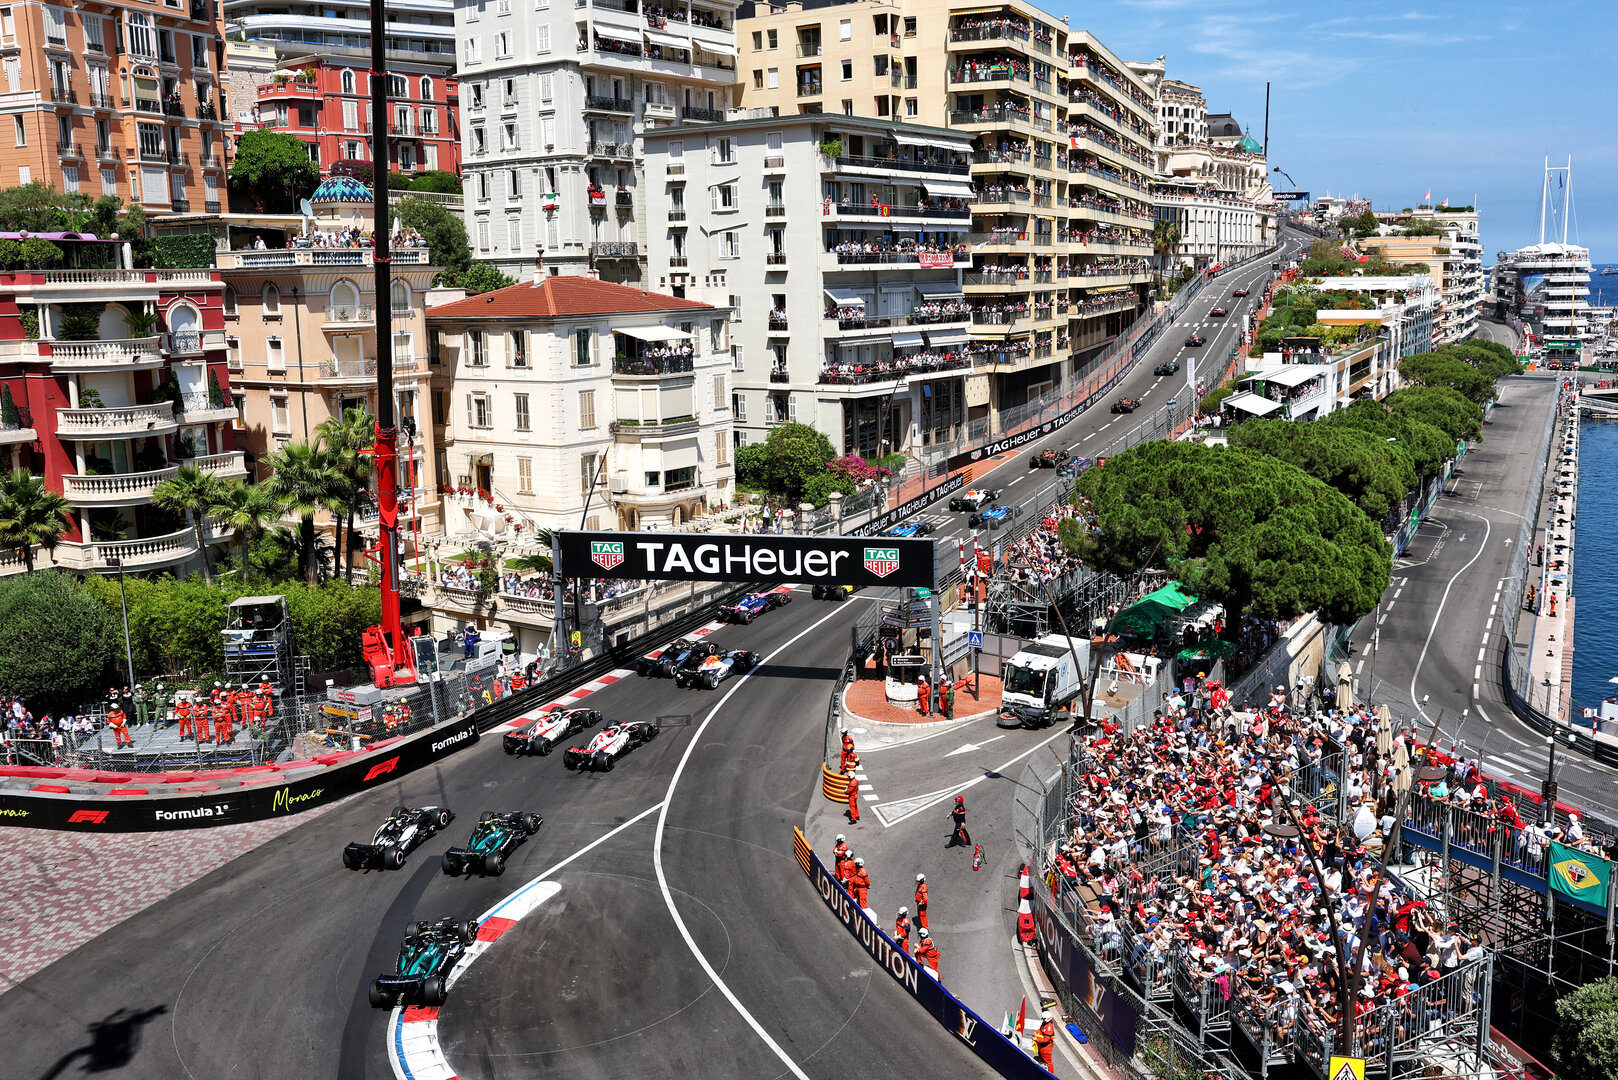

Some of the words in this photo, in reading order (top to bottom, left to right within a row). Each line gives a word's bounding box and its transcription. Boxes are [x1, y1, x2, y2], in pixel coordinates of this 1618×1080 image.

[594, 543, 621, 552] TAG
[867, 550, 896, 560] TAG
[593, 554, 623, 569] HEUER
[866, 561, 898, 576] HEUER
[432, 731, 468, 753] Formula
[272, 787, 325, 812] Monaco
[155, 807, 213, 821] Formula
[817, 867, 850, 925] LOUIS
[852, 909, 918, 995] VUITTON
